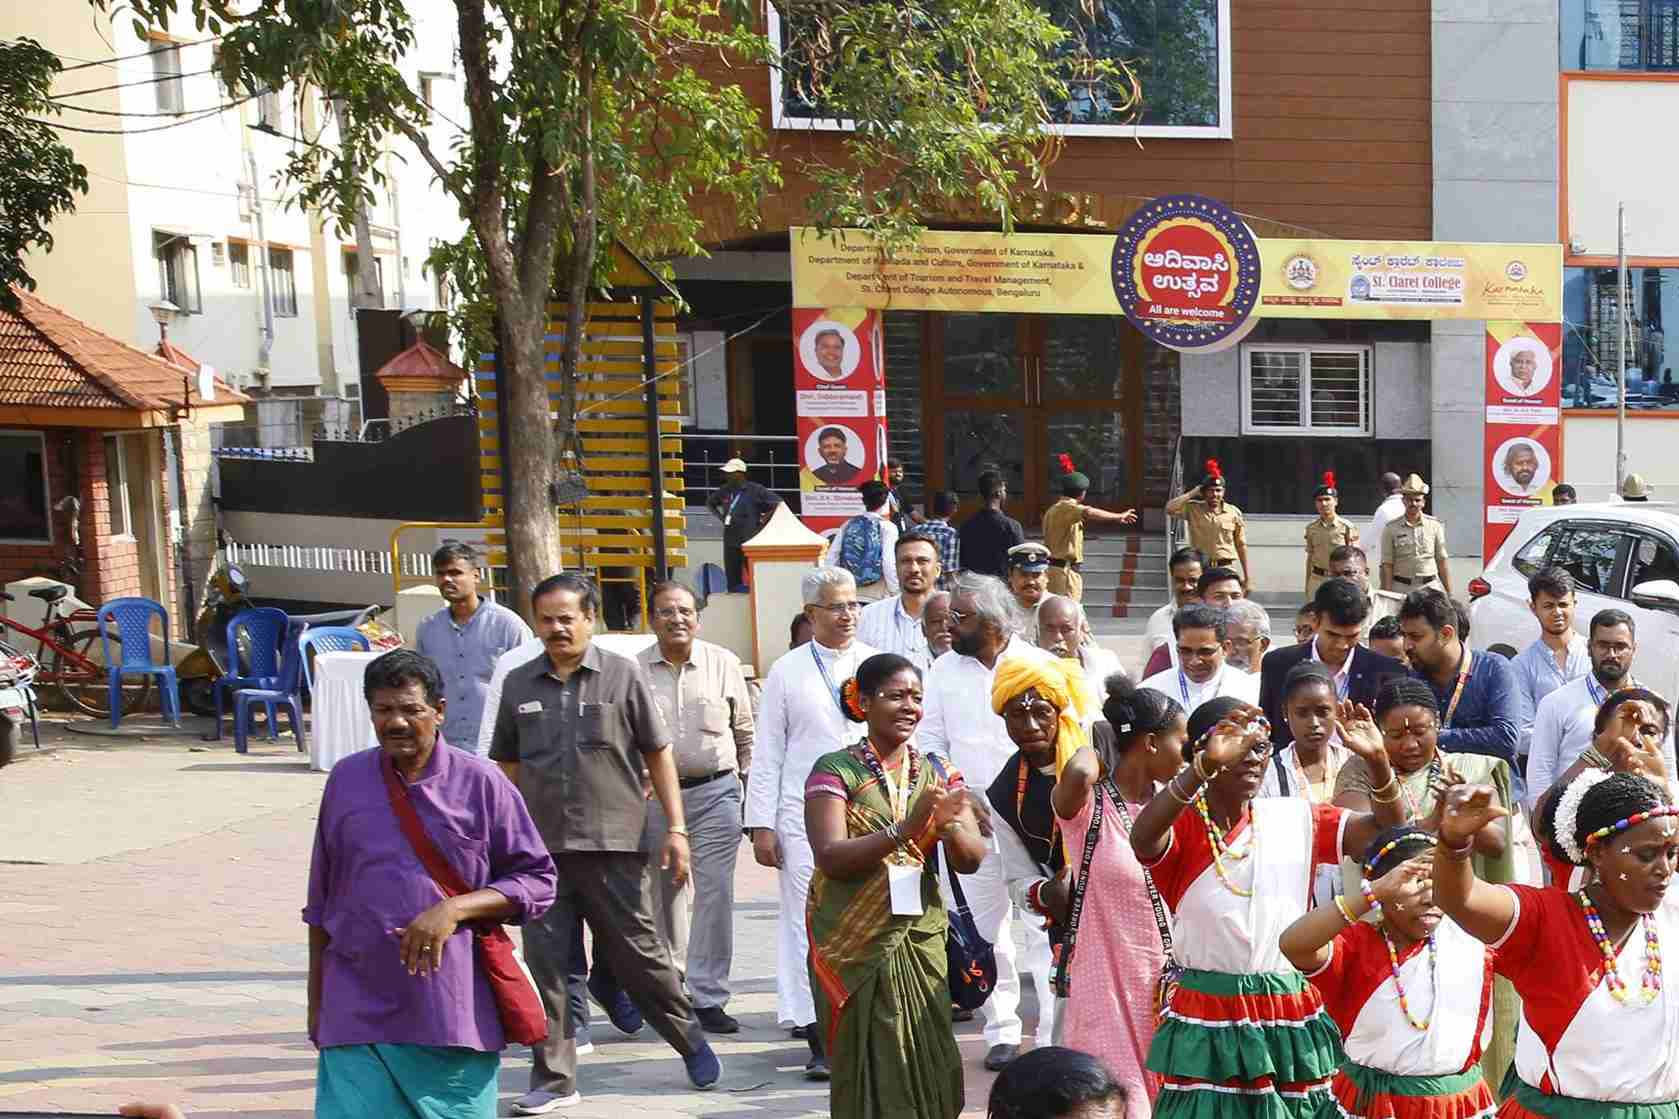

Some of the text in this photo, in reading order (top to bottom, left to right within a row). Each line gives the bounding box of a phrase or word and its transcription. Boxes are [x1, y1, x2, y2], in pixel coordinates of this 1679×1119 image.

[944, 246, 996, 256] Government
[999, 246, 1008, 256] of
[808, 255, 861, 266] Department
[863, 256, 872, 265] of
[913, 258, 929, 267] and
[966, 259, 1017, 269] Government
[1020, 260, 1030, 270] of
[1032, 261, 1077, 270] Karnataka
[899, 273, 909, 282] of
[911, 274, 945, 283] Tourism
[947, 275, 964, 284] and
[965, 275, 991, 284] Travel
[1153, 272, 1219, 299] ಉತ್ಸವ
[1372, 275, 1462, 290] St. Claret College
[902, 286, 936, 297] College
[996, 288, 1041, 298] Bengaluru
[1149, 304, 1225, 318] All are welcome
